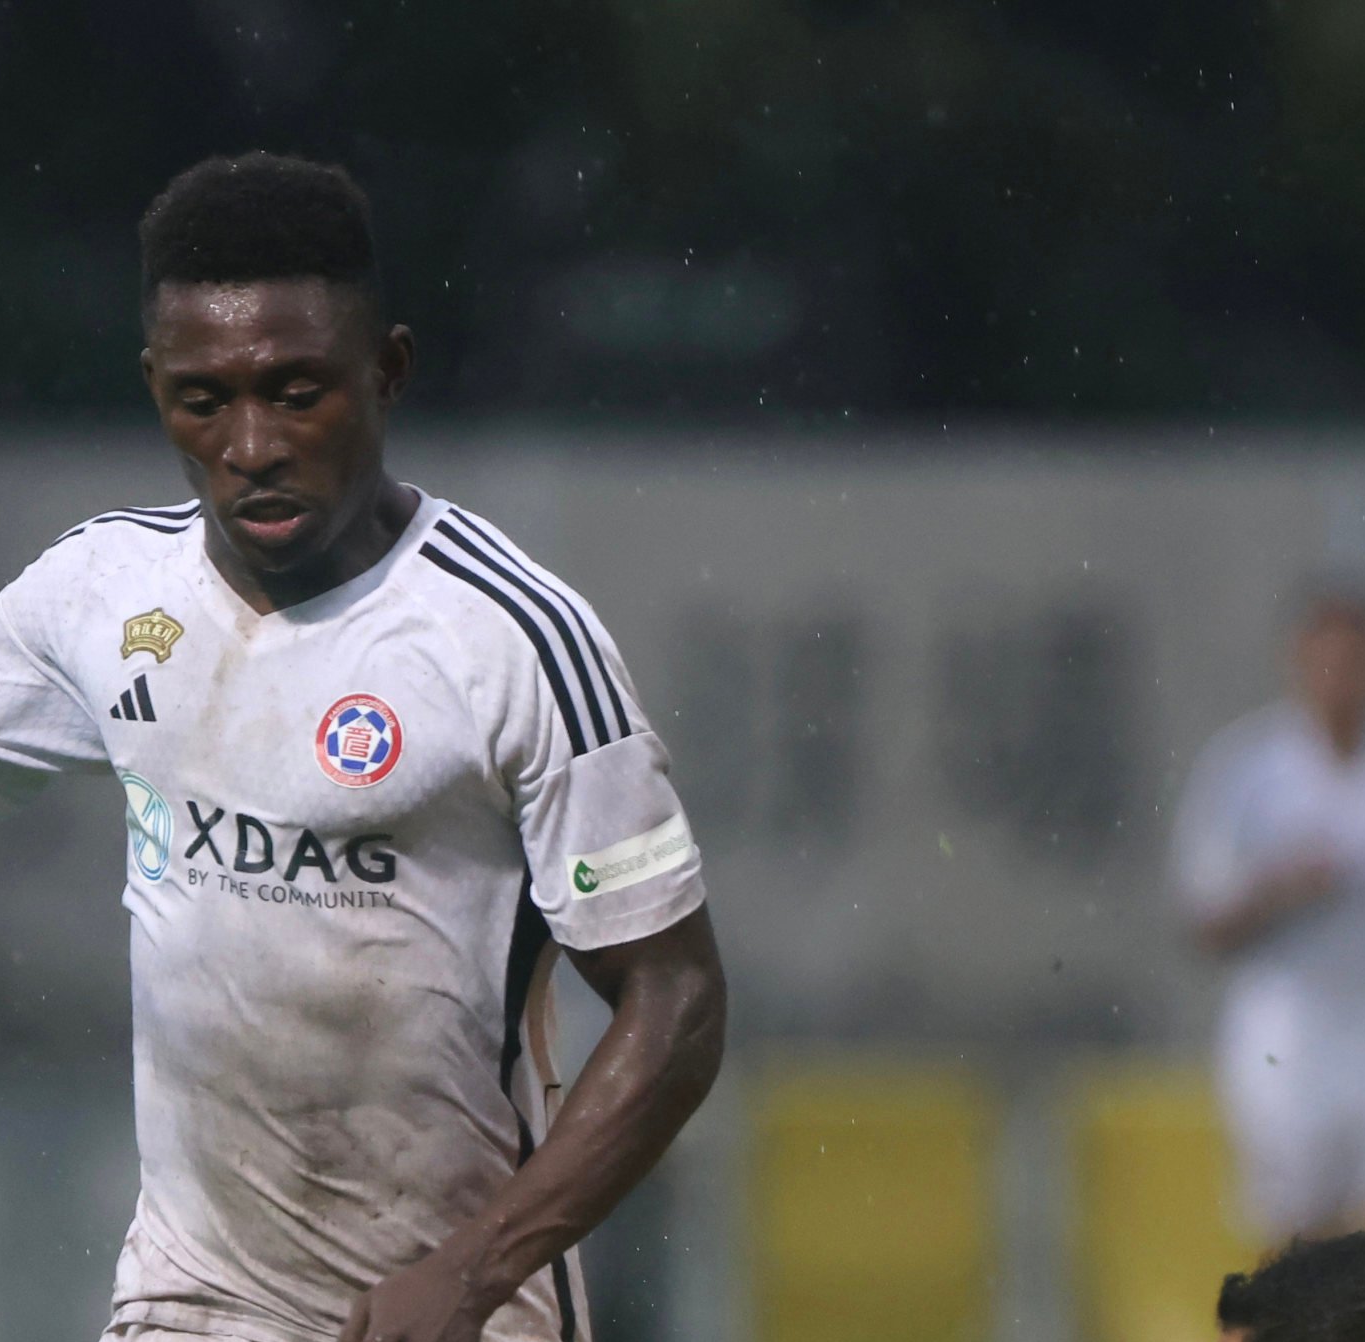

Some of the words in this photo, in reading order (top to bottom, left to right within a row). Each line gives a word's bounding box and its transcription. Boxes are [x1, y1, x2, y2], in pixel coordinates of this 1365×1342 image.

[185, 801, 396, 883] XDAG
[188, 868, 209, 885] BY
[218, 874, 249, 899] THE
[257, 884, 395, 909] COMMUNITY
